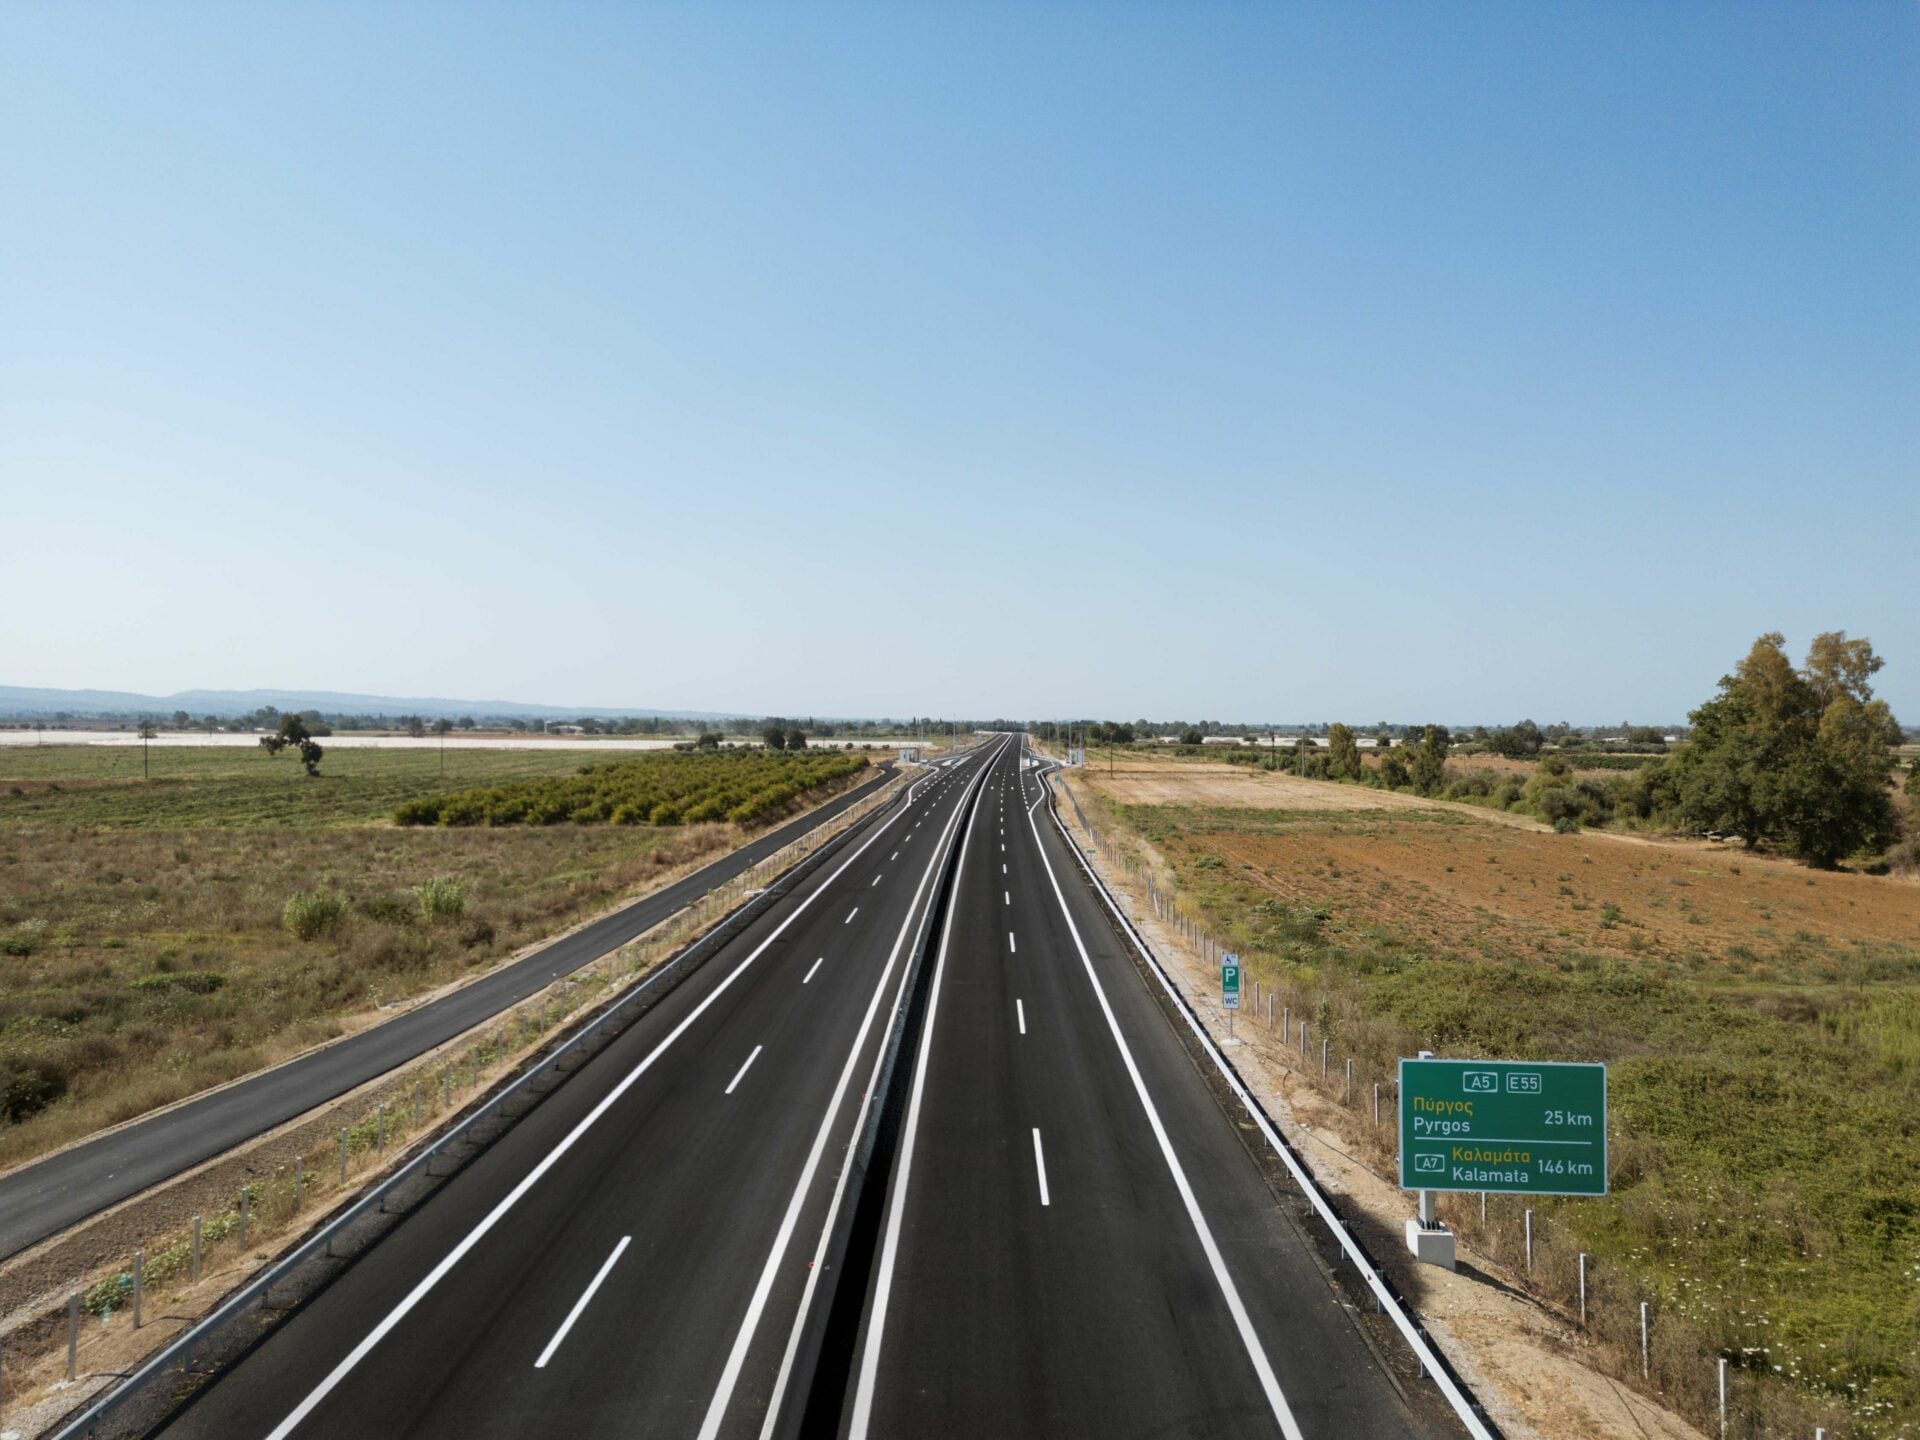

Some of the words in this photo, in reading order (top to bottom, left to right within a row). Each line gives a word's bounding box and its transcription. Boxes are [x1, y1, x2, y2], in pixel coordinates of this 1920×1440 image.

[1225, 968, 1236, 982] P
[1225, 997, 1238, 1005] WC
[1471, 1076, 1490, 1088] A5
[1413, 1097, 1474, 1116] Πύργος
[1544, 1110, 1563, 1125] 25
[1567, 1111, 1592, 1126] km
[1413, 1117, 1471, 1135] Pyrgos
[1422, 1157, 1437, 1169] A7
[1452, 1147, 1530, 1165] Καλαμάτα
[1452, 1166, 1529, 1183] Kalamata
[1537, 1160, 1564, 1174] 146
[1568, 1161, 1593, 1175] km
